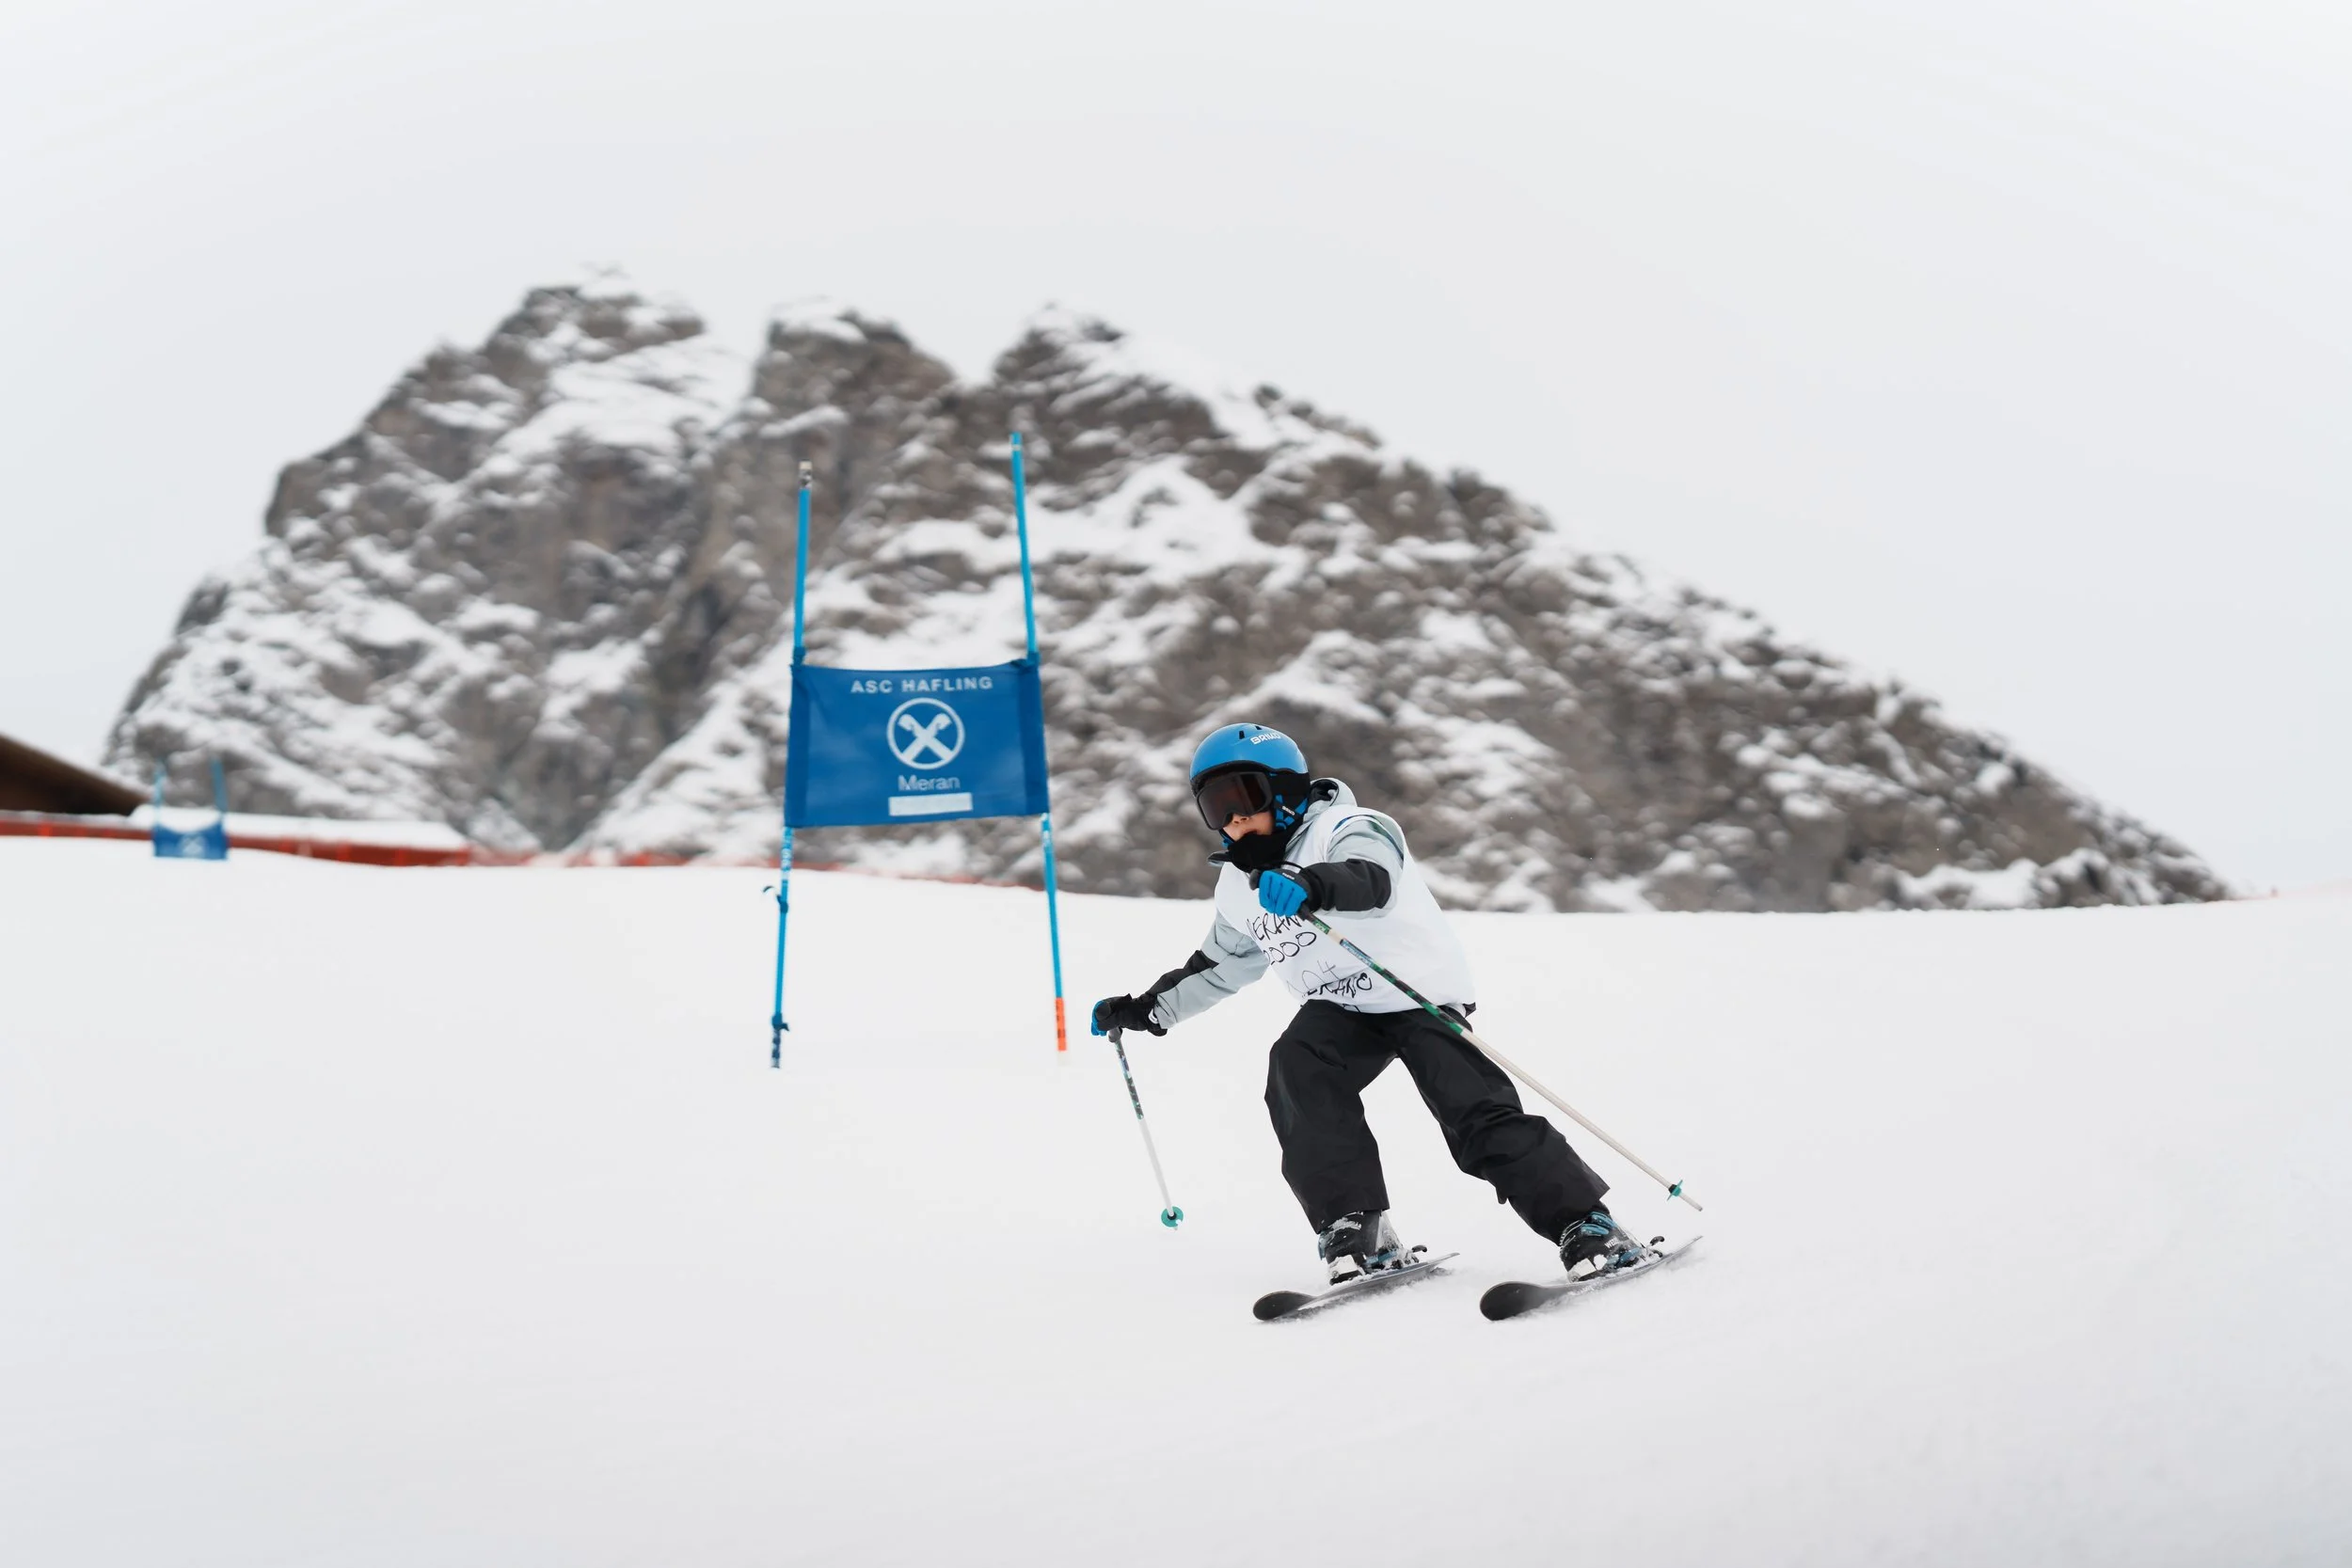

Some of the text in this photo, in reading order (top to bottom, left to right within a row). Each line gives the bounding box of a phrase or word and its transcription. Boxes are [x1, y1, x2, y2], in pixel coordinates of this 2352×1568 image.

[850, 676, 993, 693] ASC HAFLING
[898, 775, 961, 791] Meran
